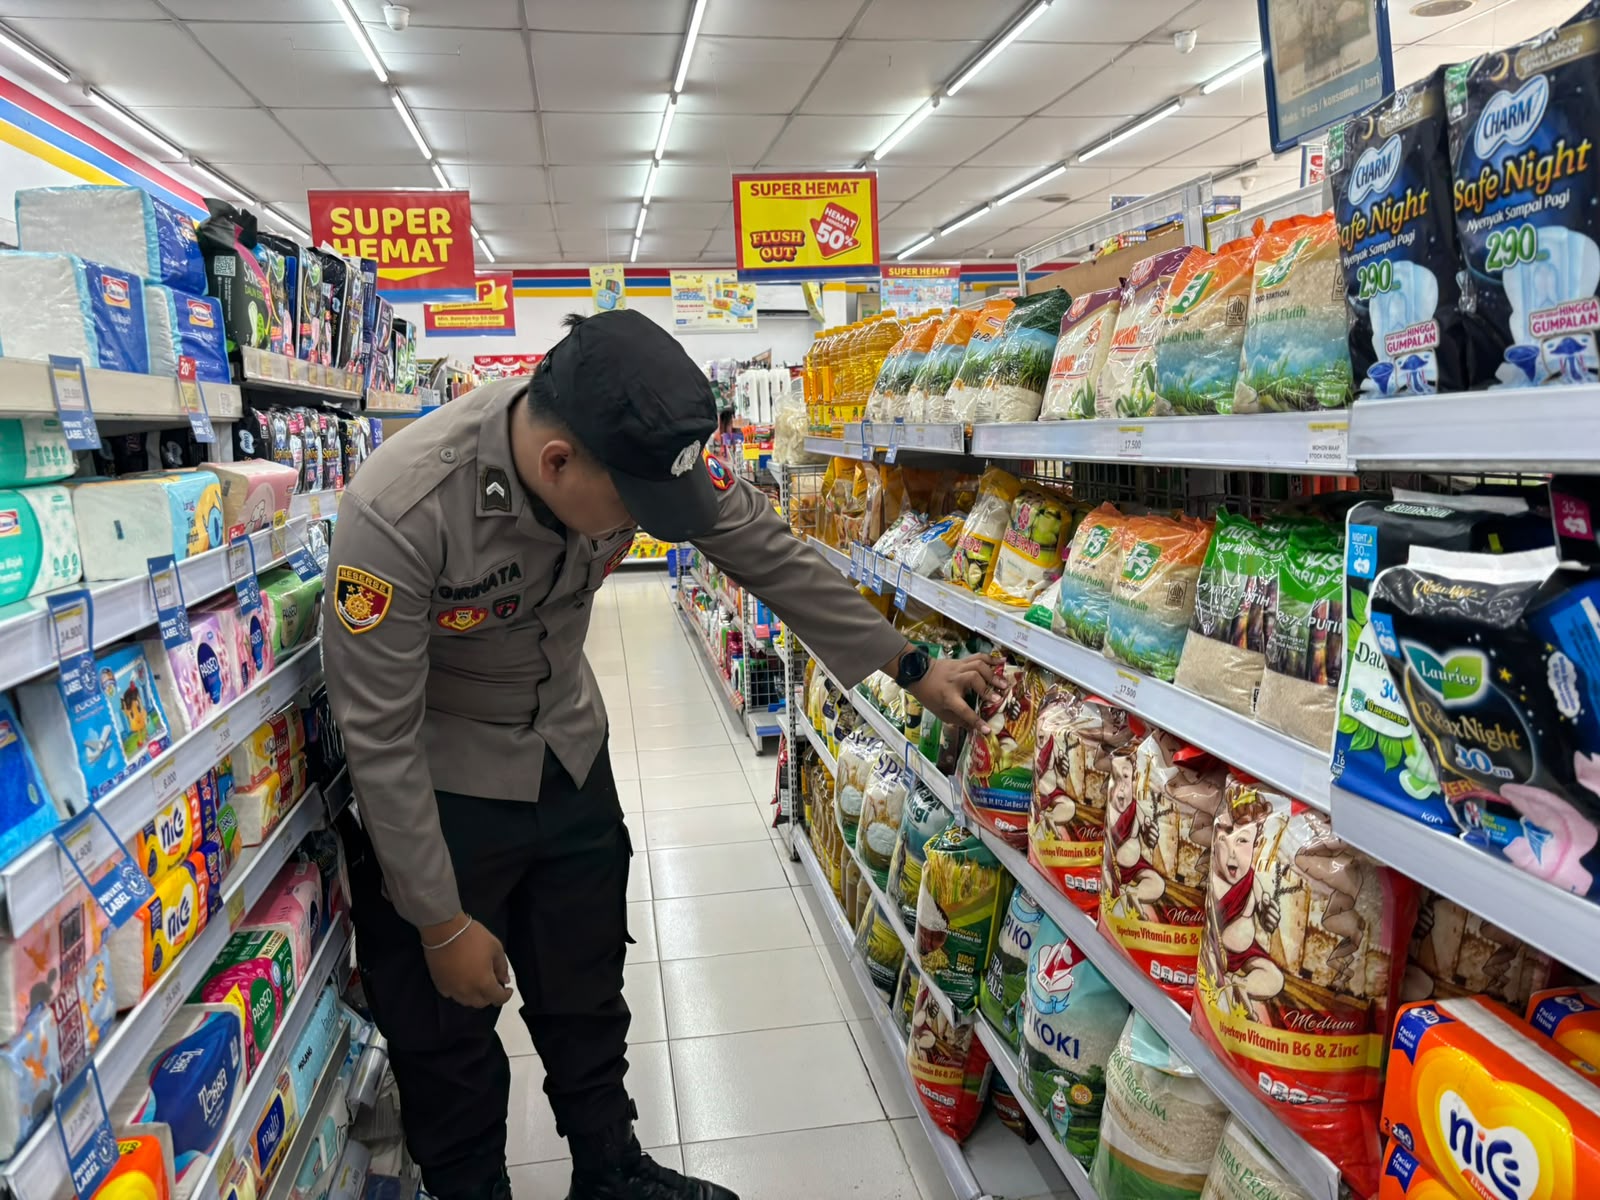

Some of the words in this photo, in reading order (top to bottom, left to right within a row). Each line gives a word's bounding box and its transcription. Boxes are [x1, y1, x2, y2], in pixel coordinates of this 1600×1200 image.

[1323, 84, 1360, 108] konsumen
[1484, 98, 1534, 139] CHARM
[1355, 155, 1392, 189] CHARM
[1503, 139, 1593, 195] Night
[750, 182, 802, 197] SUPER
[805, 181, 860, 195] HEMAT
[1368, 187, 1429, 236] Night
[1504, 199, 1543, 222] Sampai
[1544, 187, 1572, 209] Pagi
[330, 207, 453, 235] SUPER
[825, 207, 857, 228] HEMAT
[752, 230, 804, 245] FLUSH
[816, 222, 853, 250] 50%
[1368, 237, 1397, 259] Sampai
[1397, 229, 1416, 248] Pagi
[333, 238, 453, 263] HEMAT
[761, 246, 795, 259] OUT
[1486, 223, 1536, 273] 290
[888, 267, 918, 276] SUPER
[920, 267, 951, 275] HEMAT
[1357, 258, 1393, 300] 290
[1280, 305, 1307, 320] Putih
[1559, 300, 1598, 317] HINGGA
[1407, 323, 1435, 336] HINGGA
[1532, 312, 1600, 335] GUMPALAN
[1387, 332, 1437, 353] GUMPALAN
[66, 430, 86, 440] LABEL
[1124, 440, 1142, 451] 17.500
[163, 627, 180, 640] LABEL
[200, 656, 220, 679] PASEO
[1355, 641, 1387, 672] Dau
[1421, 661, 1477, 688] Laurier
[65, 680, 83, 696] LABEL
[1119, 684, 1137, 700] 17.500
[1055, 845, 1083, 859] Vitamin
[1084, 846, 1097, 859] B6
[98, 881, 125, 906] PRIVATE
[104, 892, 132, 917] LABEL
[1140, 927, 1172, 944] Vitamin
[1173, 932, 1188, 945] B6
[1190, 932, 1199, 945] &
[251, 987, 273, 1024] PASEO
[1538, 1006, 1557, 1023] Facial
[1284, 1009, 1356, 1032] Medium
[1535, 1012, 1553, 1030] Tissue
[1033, 1013, 1080, 1060] KOKI
[1247, 1028, 1290, 1055] Vitamin
[1292, 1041, 1312, 1057] B6
[1314, 1043, 1327, 1058] &
[1328, 1043, 1360, 1059] Zinc
[1397, 1031, 1415, 1049] Tissue
[1400, 1025, 1417, 1042] Facial
[198, 1068, 229, 1121] Tessa
[73, 1149, 98, 1180] PRIVATE
[1392, 1159, 1409, 1178] Tissue
[1394, 1152, 1412, 1170] Facial
[76, 1163, 101, 1194] LABEL
